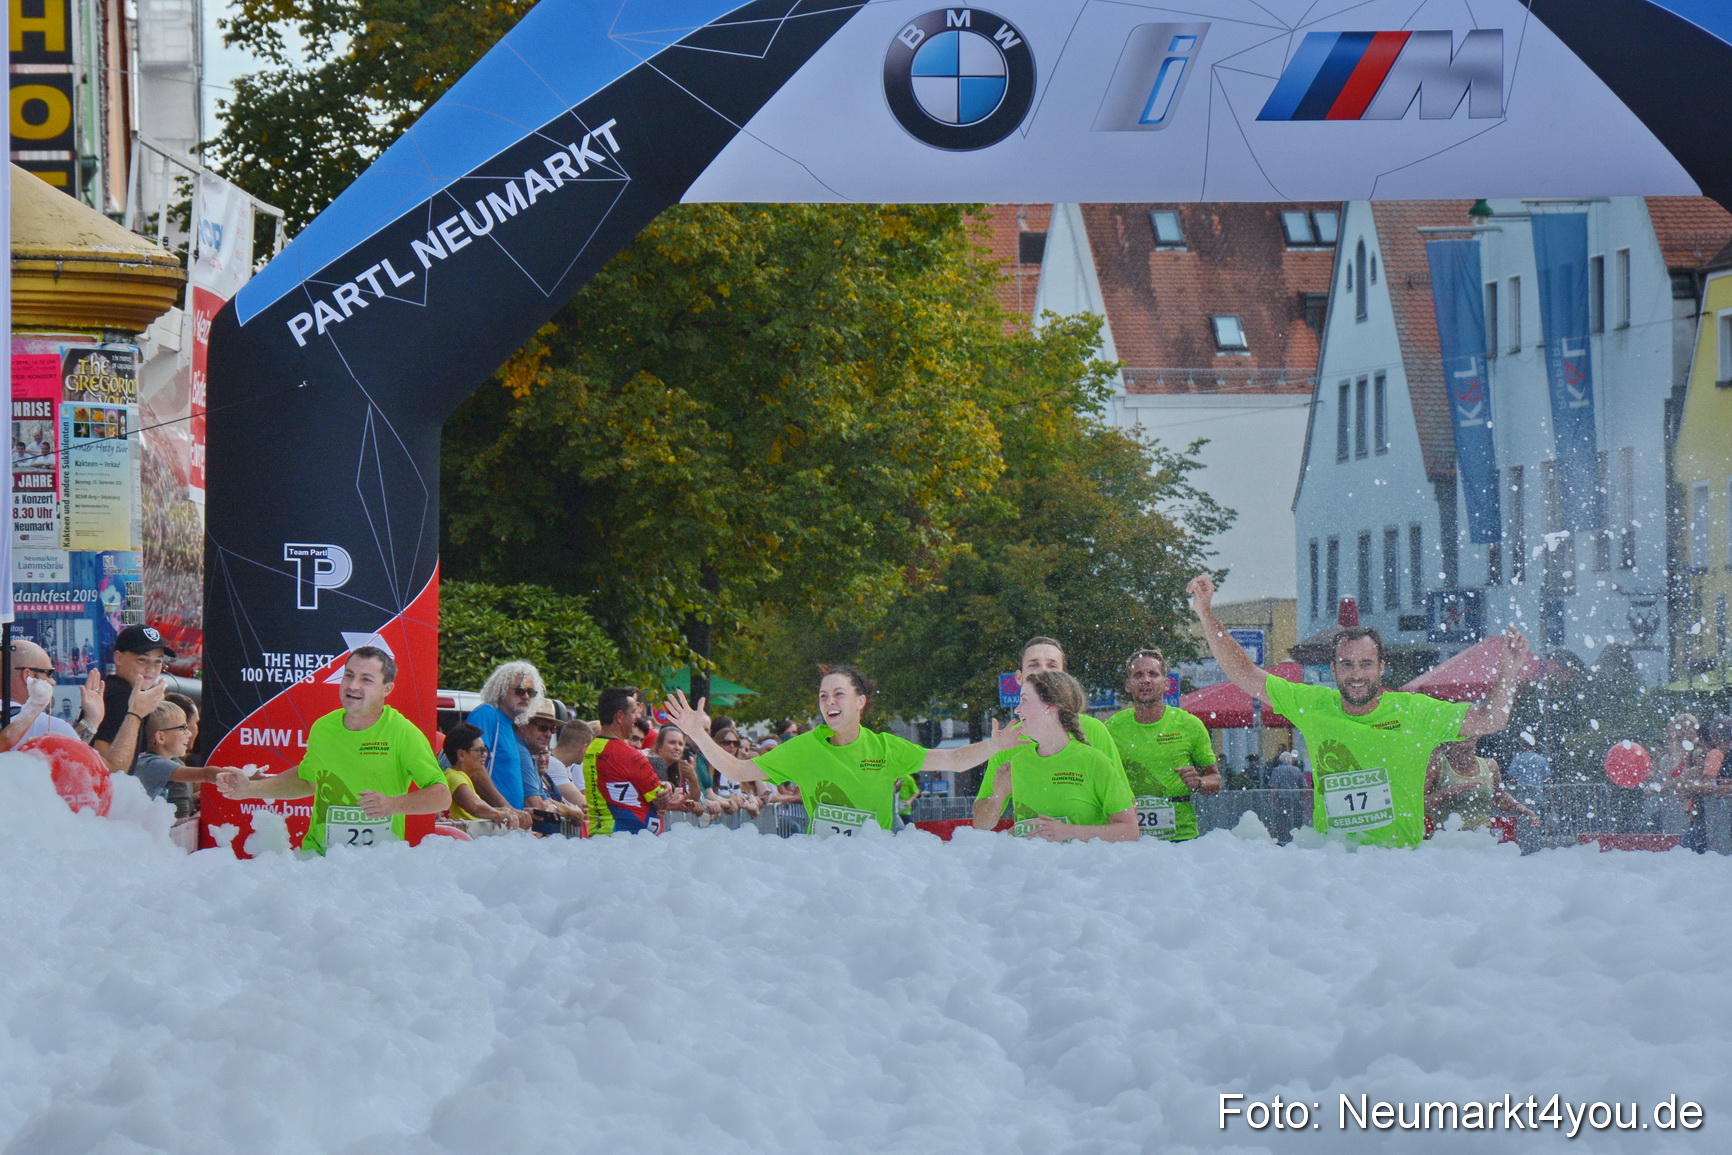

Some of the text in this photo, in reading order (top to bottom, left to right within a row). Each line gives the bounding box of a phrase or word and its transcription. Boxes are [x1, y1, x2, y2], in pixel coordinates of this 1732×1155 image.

[897, 9, 1022, 50] BMW
[287, 118, 621, 347] PARTL NEUMARKT
[1453, 356, 1484, 427] K&L
[11, 401, 51, 417] NRISE
[18, 474, 53, 488] JAHRE
[61, 421, 70, 547] Kakteen und andere Sukkulenten
[21, 494, 53, 504] Konzert
[36, 507, 53, 518] Uhr
[14, 521, 54, 532] Neumarkt
[288, 548, 309, 556] Team
[18, 561, 64, 570] Lammsbräu
[14, 589, 98, 604] dankfest 2019
[262, 653, 334, 669] THE NEXT
[240, 668, 315, 684] 100 YEARS
[240, 727, 292, 747] BMW
[1324, 770, 1381, 791] BOCK
[614, 783, 629, 801] 7
[240, 801, 314, 817] www.bm
[1343, 791, 1369, 812] 17
[818, 805, 873, 823] BOCK
[1137, 812, 1158, 826] 28
[1333, 811, 1388, 827] SEBASTIAN
[651, 821, 659, 834] 7
